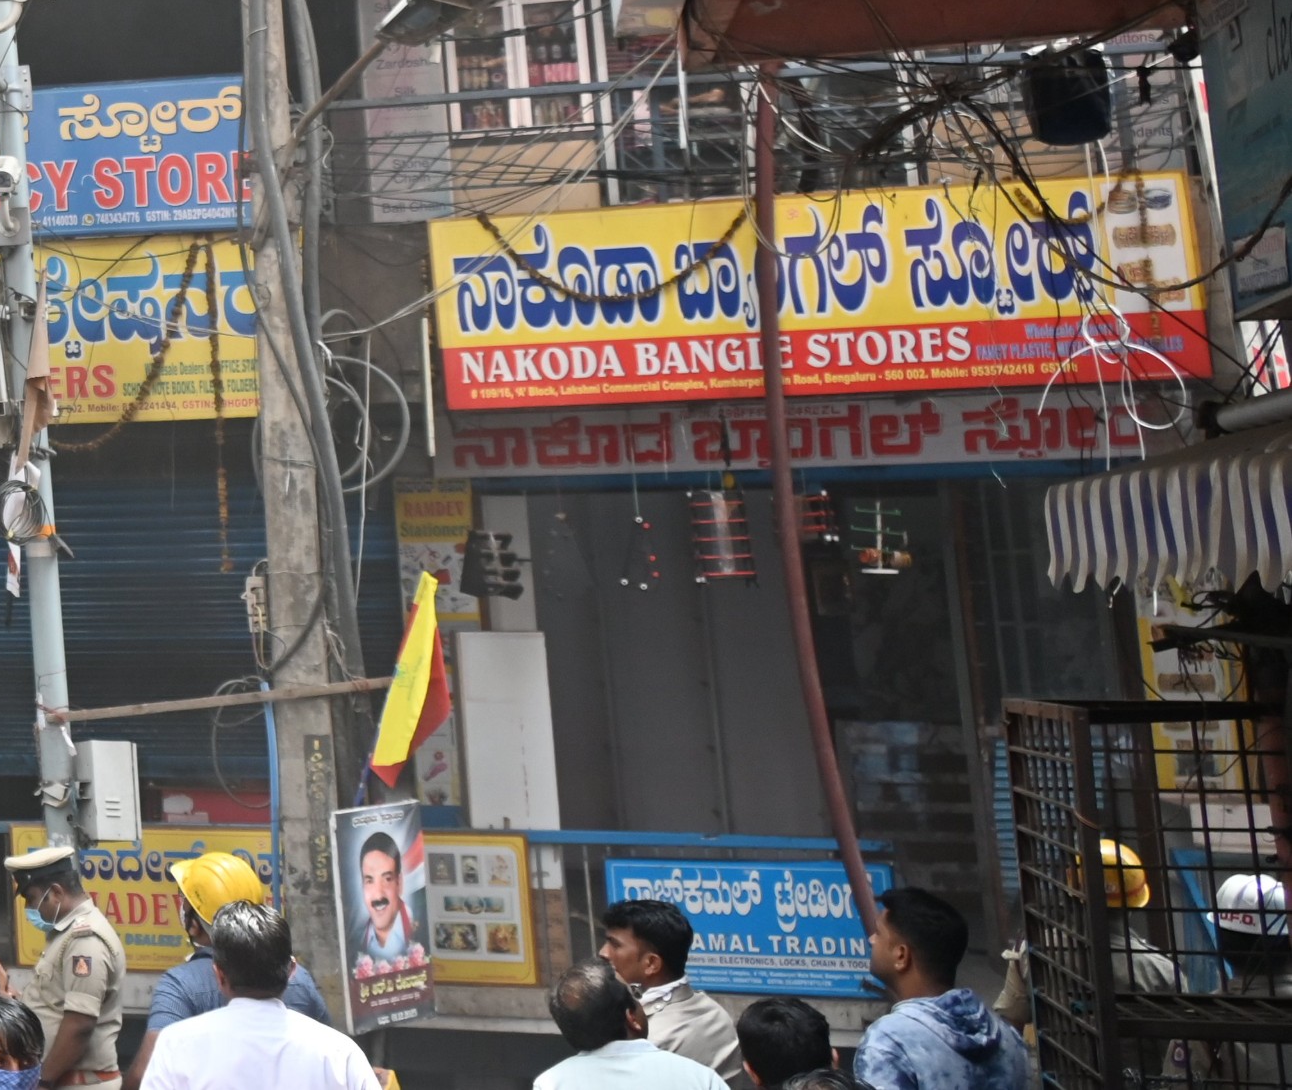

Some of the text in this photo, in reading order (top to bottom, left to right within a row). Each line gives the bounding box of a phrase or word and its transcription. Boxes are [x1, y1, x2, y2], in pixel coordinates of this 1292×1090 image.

[59, 86, 242, 153] ಸ್ಟೋರ್
[146, 210, 171, 222] GSTIN:
[461, 343, 626, 383] NAKODA
[807, 325, 972, 369] STORES
[976, 344, 1008, 360] FANCY
[180, 361, 204, 375] Dealers
[529, 385, 558, 399] Block,
[560, 383, 601, 396] Lakshmi
[603, 380, 660, 395] Commercial
[663, 377, 707, 393] Complex,
[793, 372, 821, 387] Road,
[824, 368, 876, 385] Bengaluru
[885, 369, 902, 381] 560
[905, 368, 928, 381] 002.
[931, 365, 968, 380] Mobile:
[403, 500, 465, 517] RAMDEV
[691, 932, 866, 956] AMAL TRADIN
[719, 956, 777, 968] ELECTRONICS,
[779, 958, 809, 968] LOCKS,
[811, 959, 837, 968] CHAIN
[846, 960, 870, 969] TOOL
